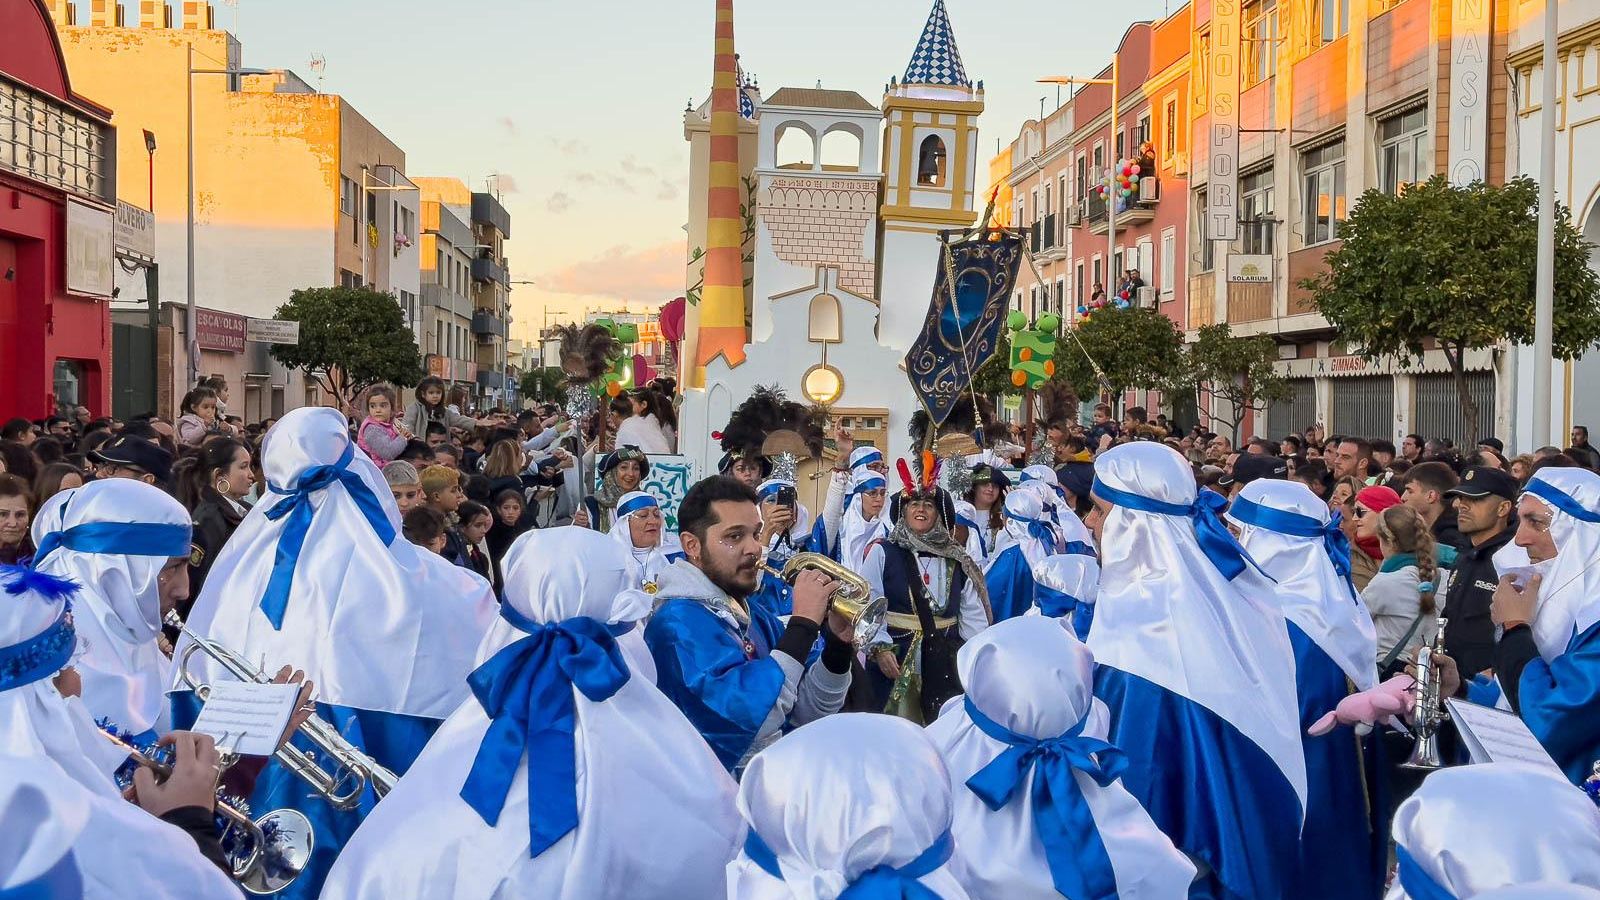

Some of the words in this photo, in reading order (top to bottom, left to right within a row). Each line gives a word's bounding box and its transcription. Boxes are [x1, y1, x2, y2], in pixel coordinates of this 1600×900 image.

[1213, 93, 1232, 237] SPORT
[197, 313, 243, 331] ESCAYOLAS
[1331, 357, 1367, 372] GIMNASIO
